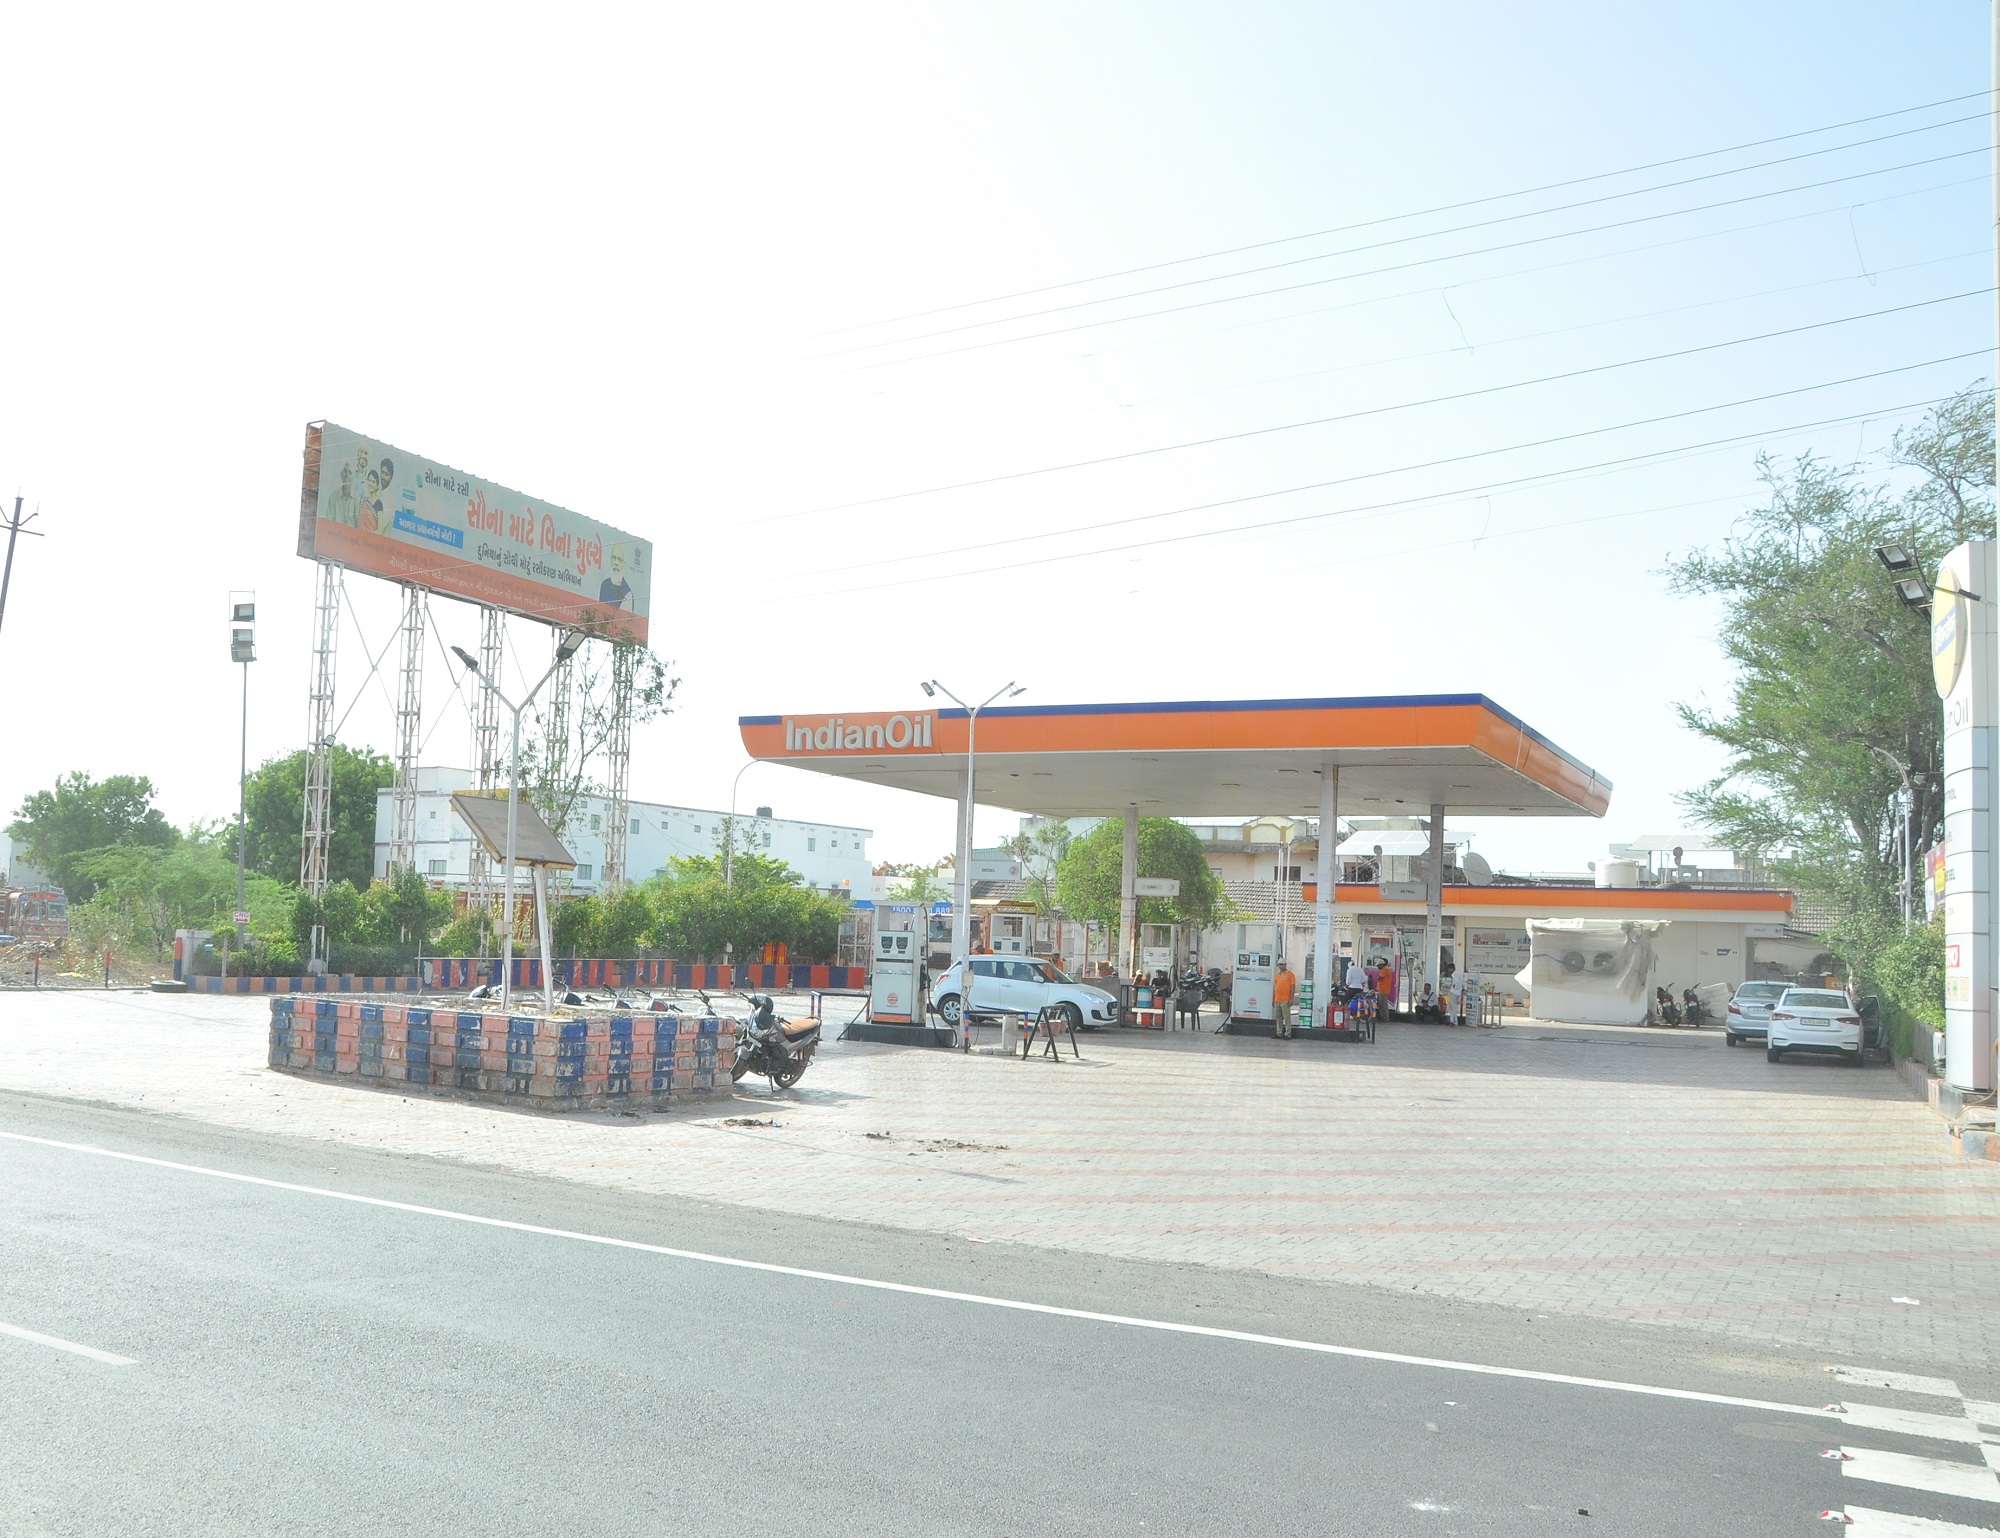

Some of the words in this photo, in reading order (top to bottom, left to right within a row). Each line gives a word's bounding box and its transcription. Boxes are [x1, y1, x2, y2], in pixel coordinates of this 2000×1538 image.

[425, 468, 441, 488] સૌના
[443, 476, 455, 492] માટે
[457, 482, 469, 497] રસી
[467, 489, 503, 537] સૌના
[509, 507, 535, 547] માટે
[540, 513, 571, 559] વિના
[532, 560, 556, 579] રસીકરણ
[558, 568, 582, 587] અભિયાન
[786, 714, 932, 750] IndianOil
